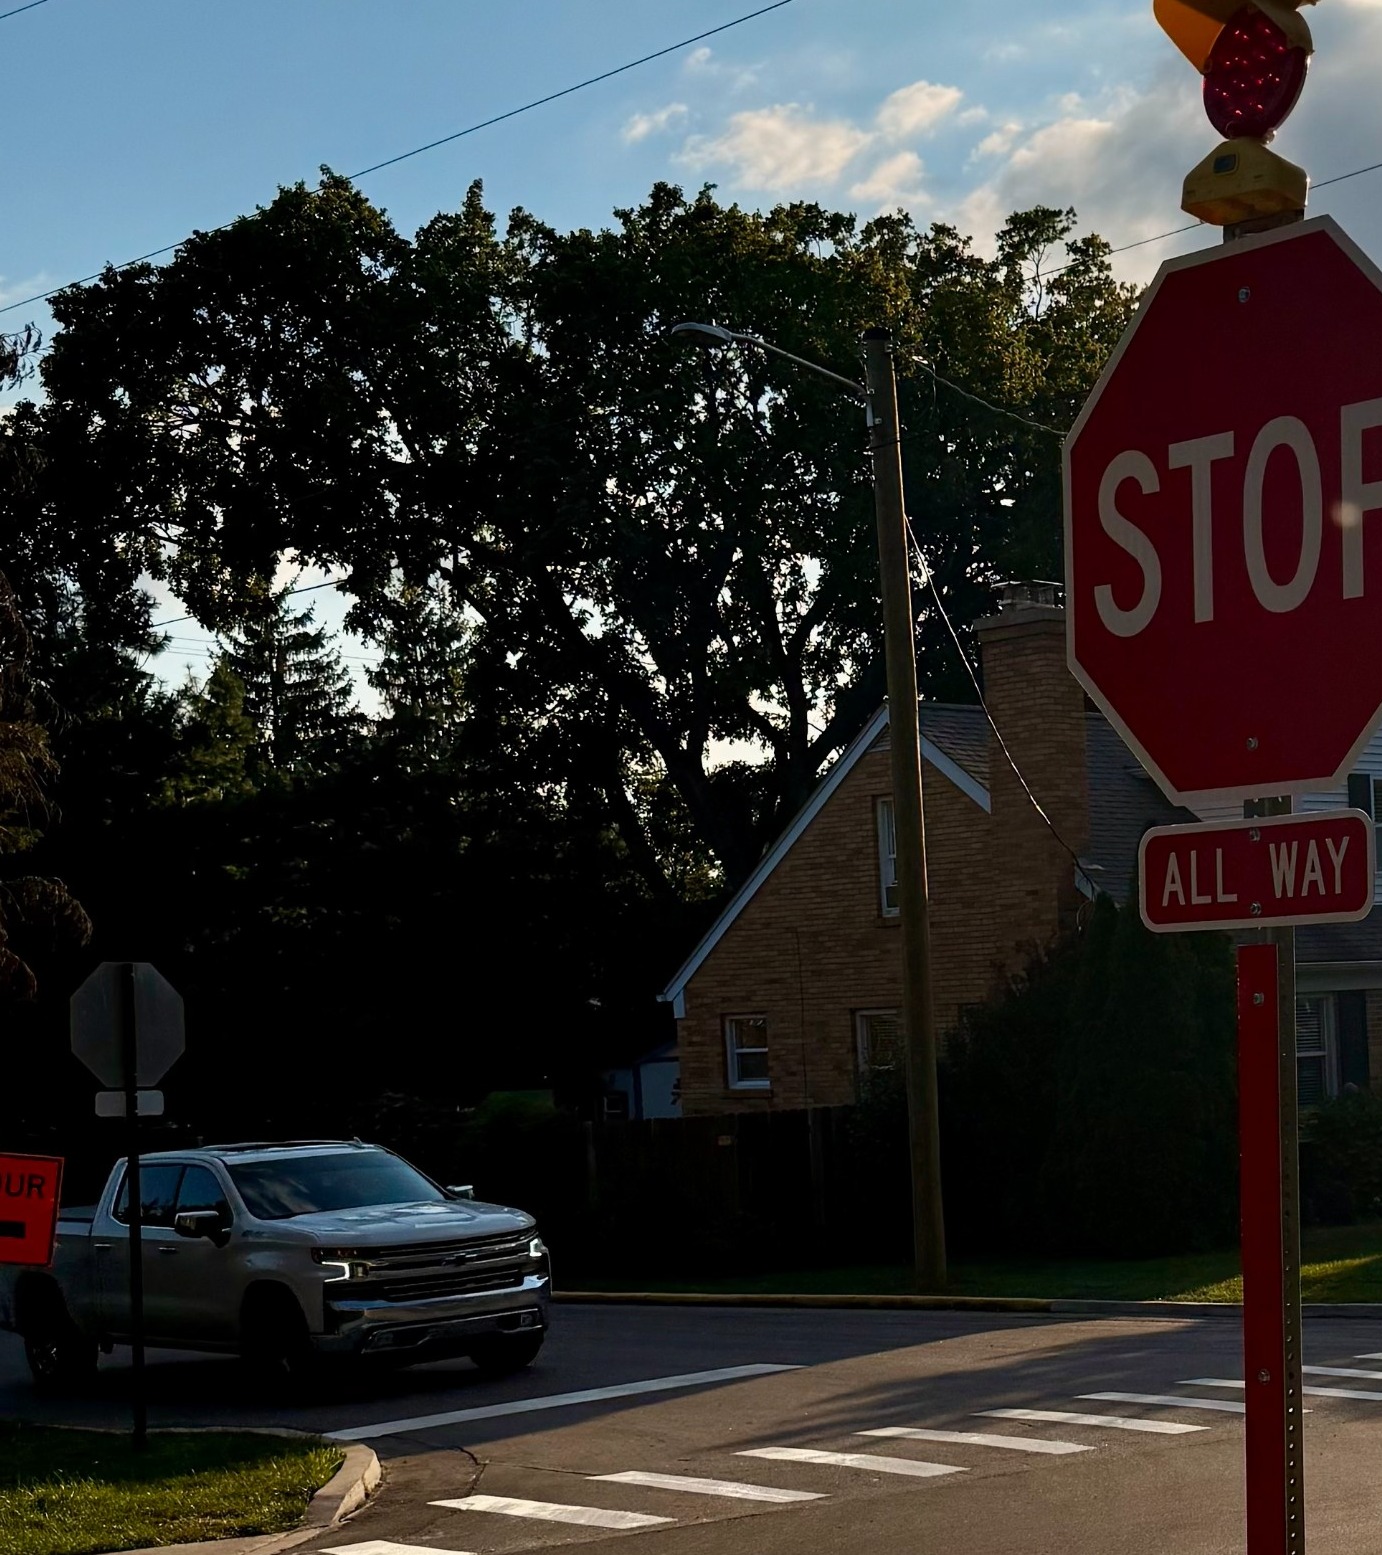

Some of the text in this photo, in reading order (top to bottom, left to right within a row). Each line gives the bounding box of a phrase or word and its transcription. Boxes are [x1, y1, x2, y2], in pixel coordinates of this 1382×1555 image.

[1162, 836, 1349, 907] ALL WAY
[0, 1171, 46, 1199] UR
